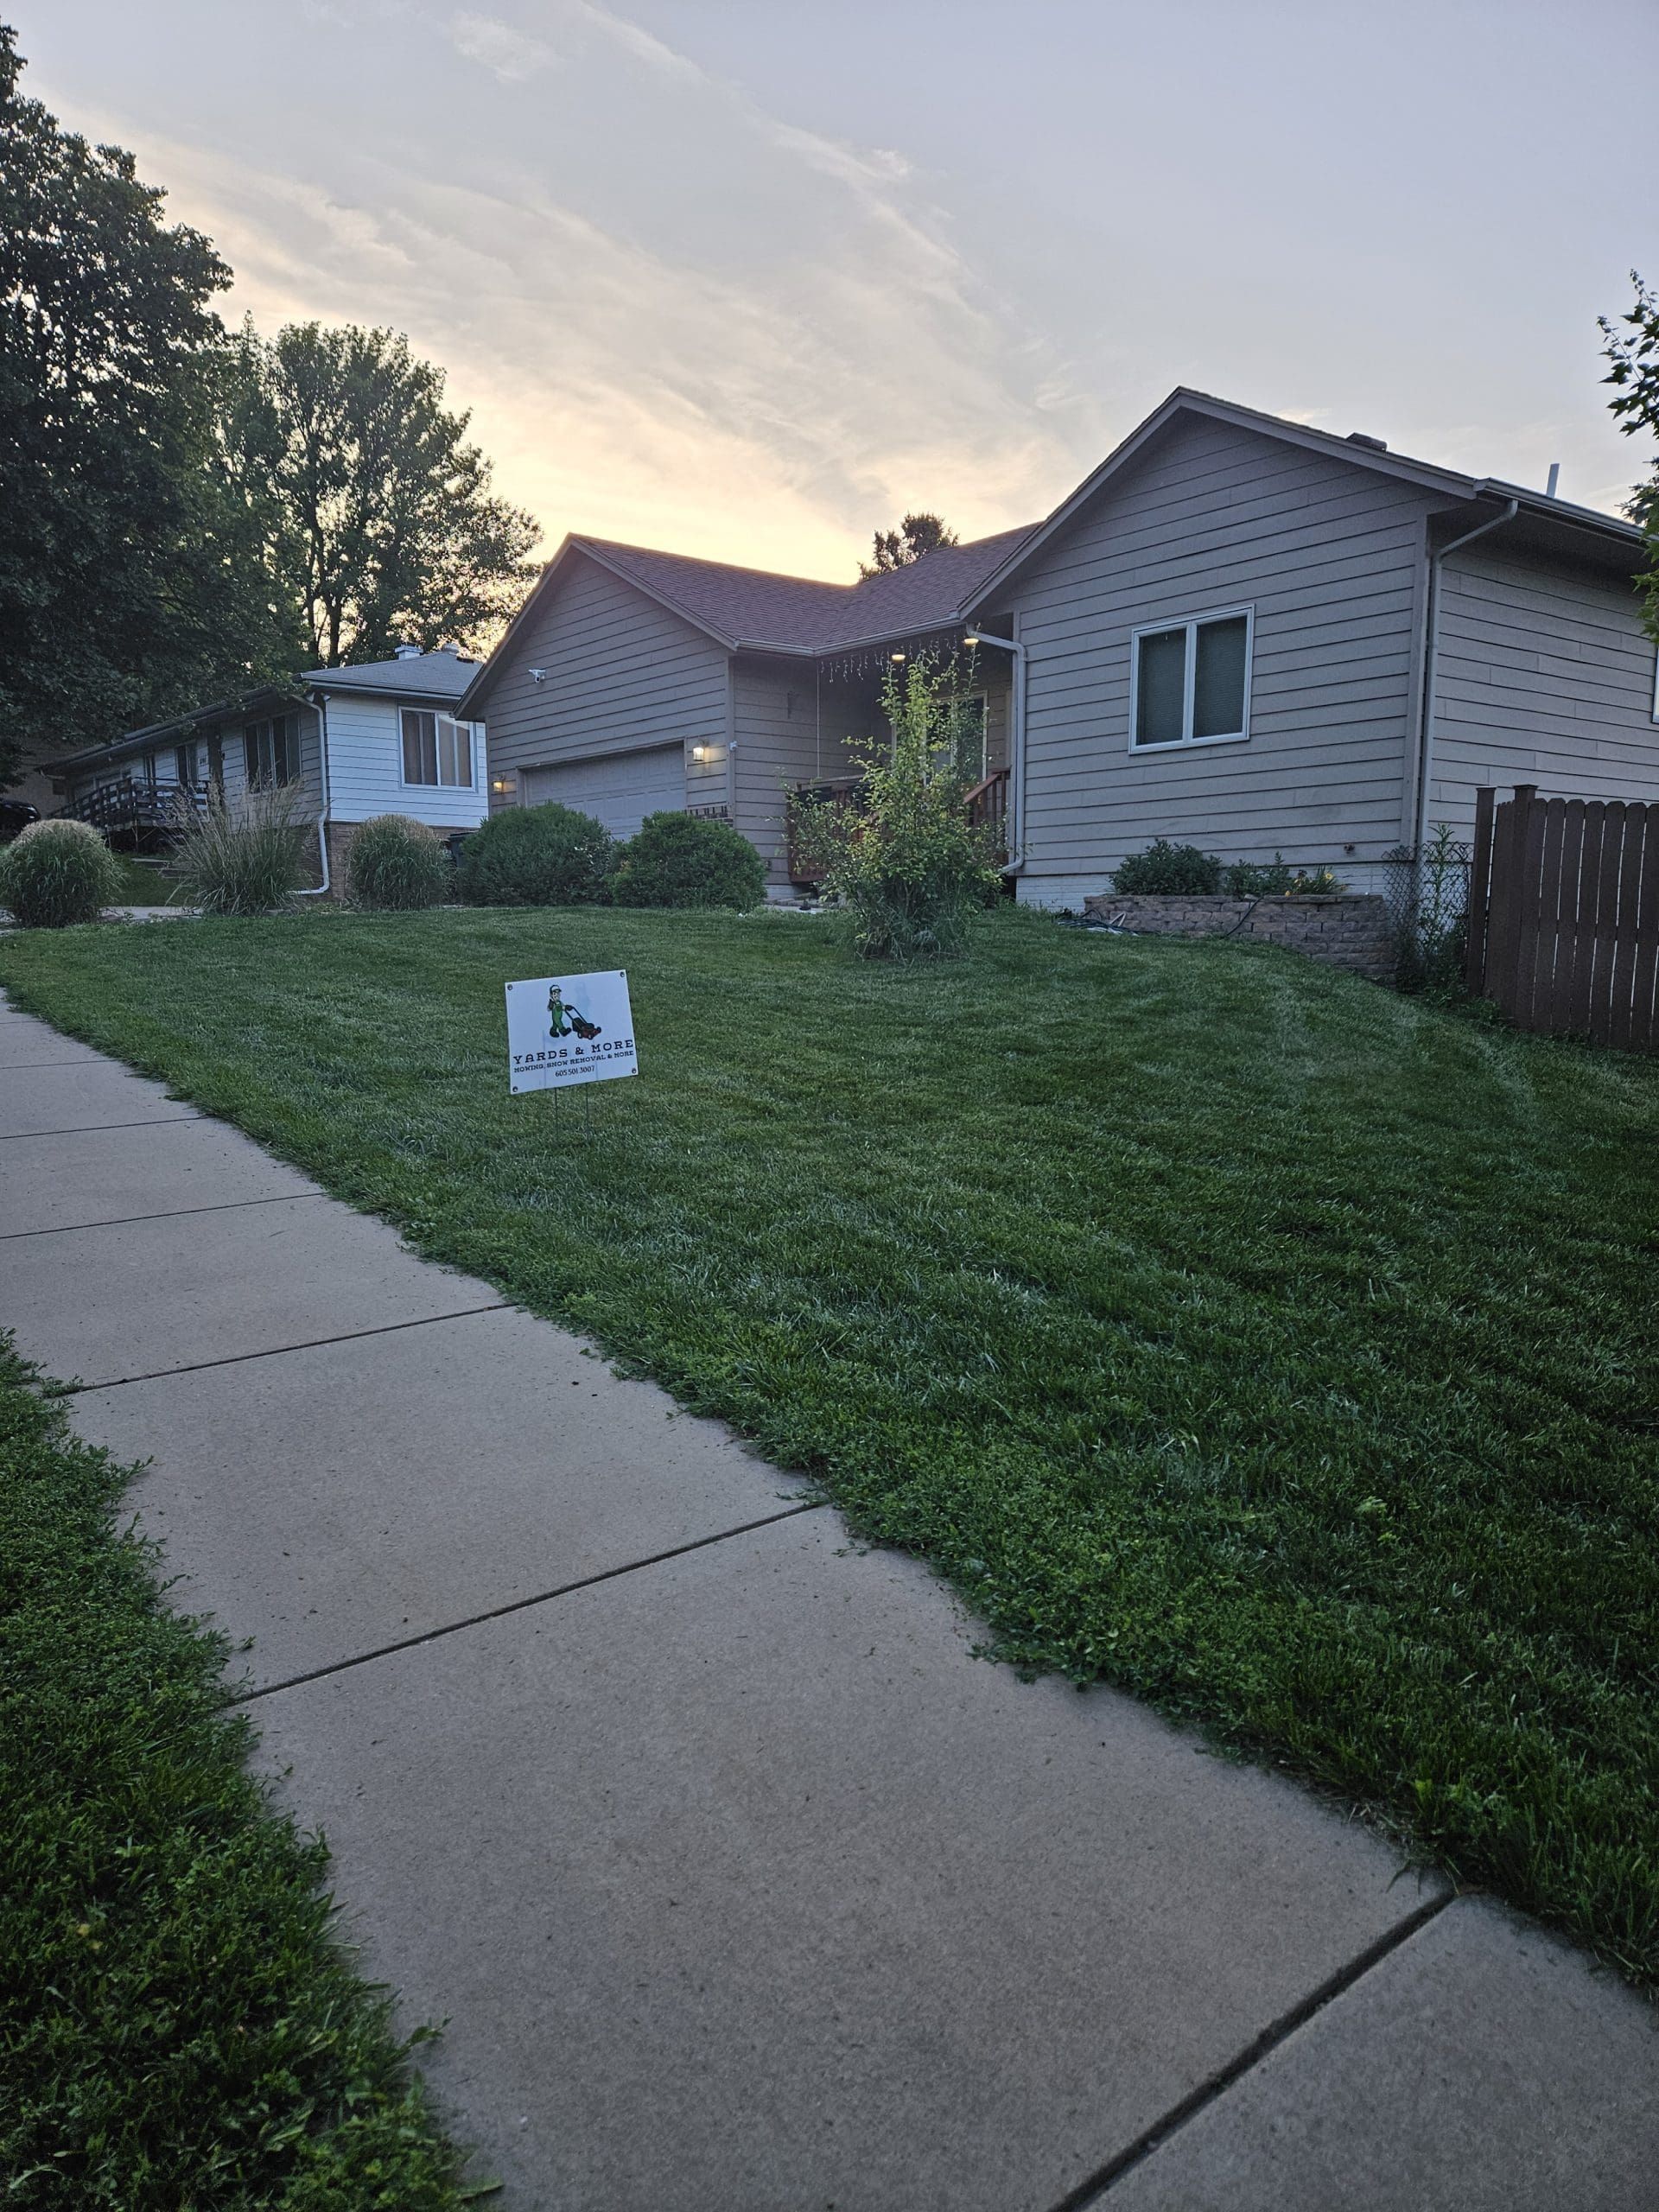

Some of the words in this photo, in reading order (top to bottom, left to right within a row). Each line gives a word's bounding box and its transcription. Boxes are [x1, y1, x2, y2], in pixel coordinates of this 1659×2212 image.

[513, 1049, 568, 1065] YARDS
[575, 1046, 584, 1055] &
[591, 1039, 633, 1053] MORE
[546, 1059, 568, 1068] SNOW
[570, 1054, 607, 1065] REMOVAL
[614, 1050, 634, 1058] MORE
[580, 1065, 594, 1074] 3007
